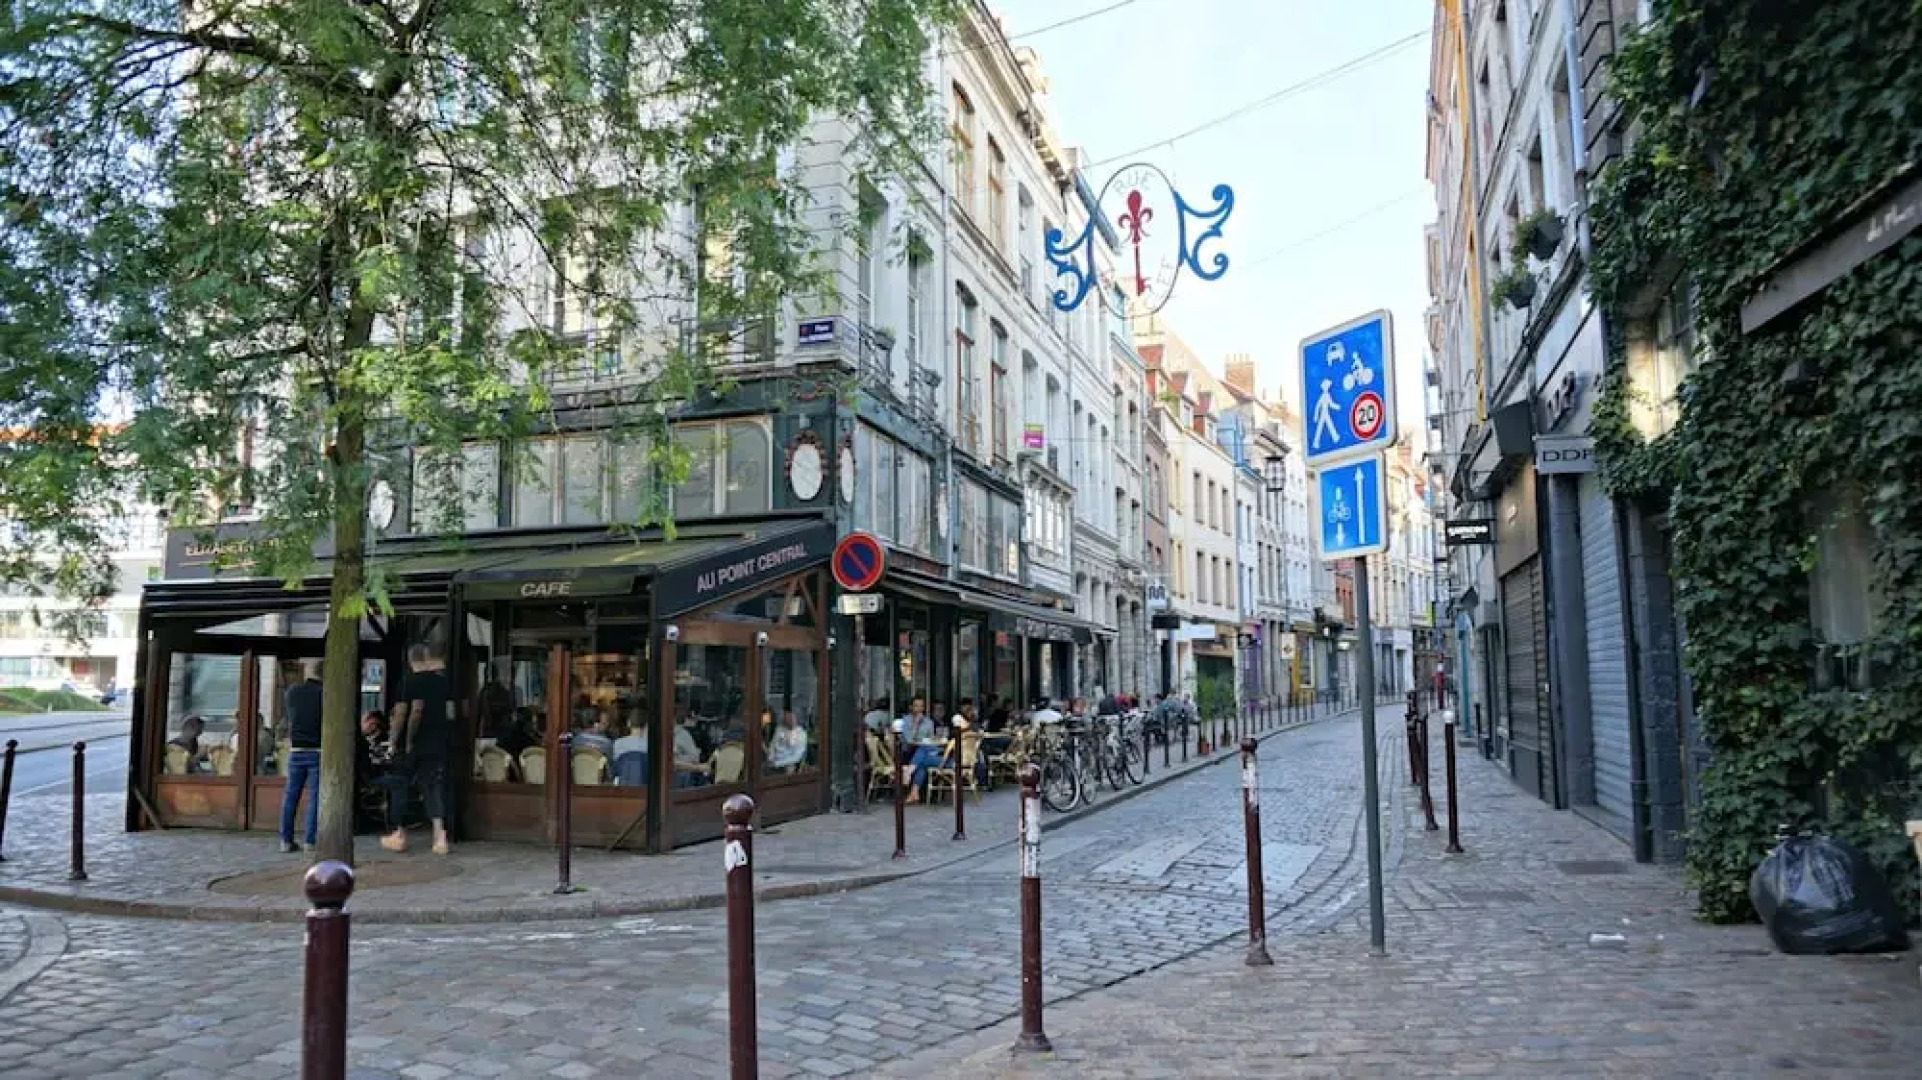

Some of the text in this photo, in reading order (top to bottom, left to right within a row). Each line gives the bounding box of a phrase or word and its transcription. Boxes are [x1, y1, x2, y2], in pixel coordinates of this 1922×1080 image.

[1359, 404, 1375, 425] 20
[697, 542, 808, 592] AU POINT CENTRAL
